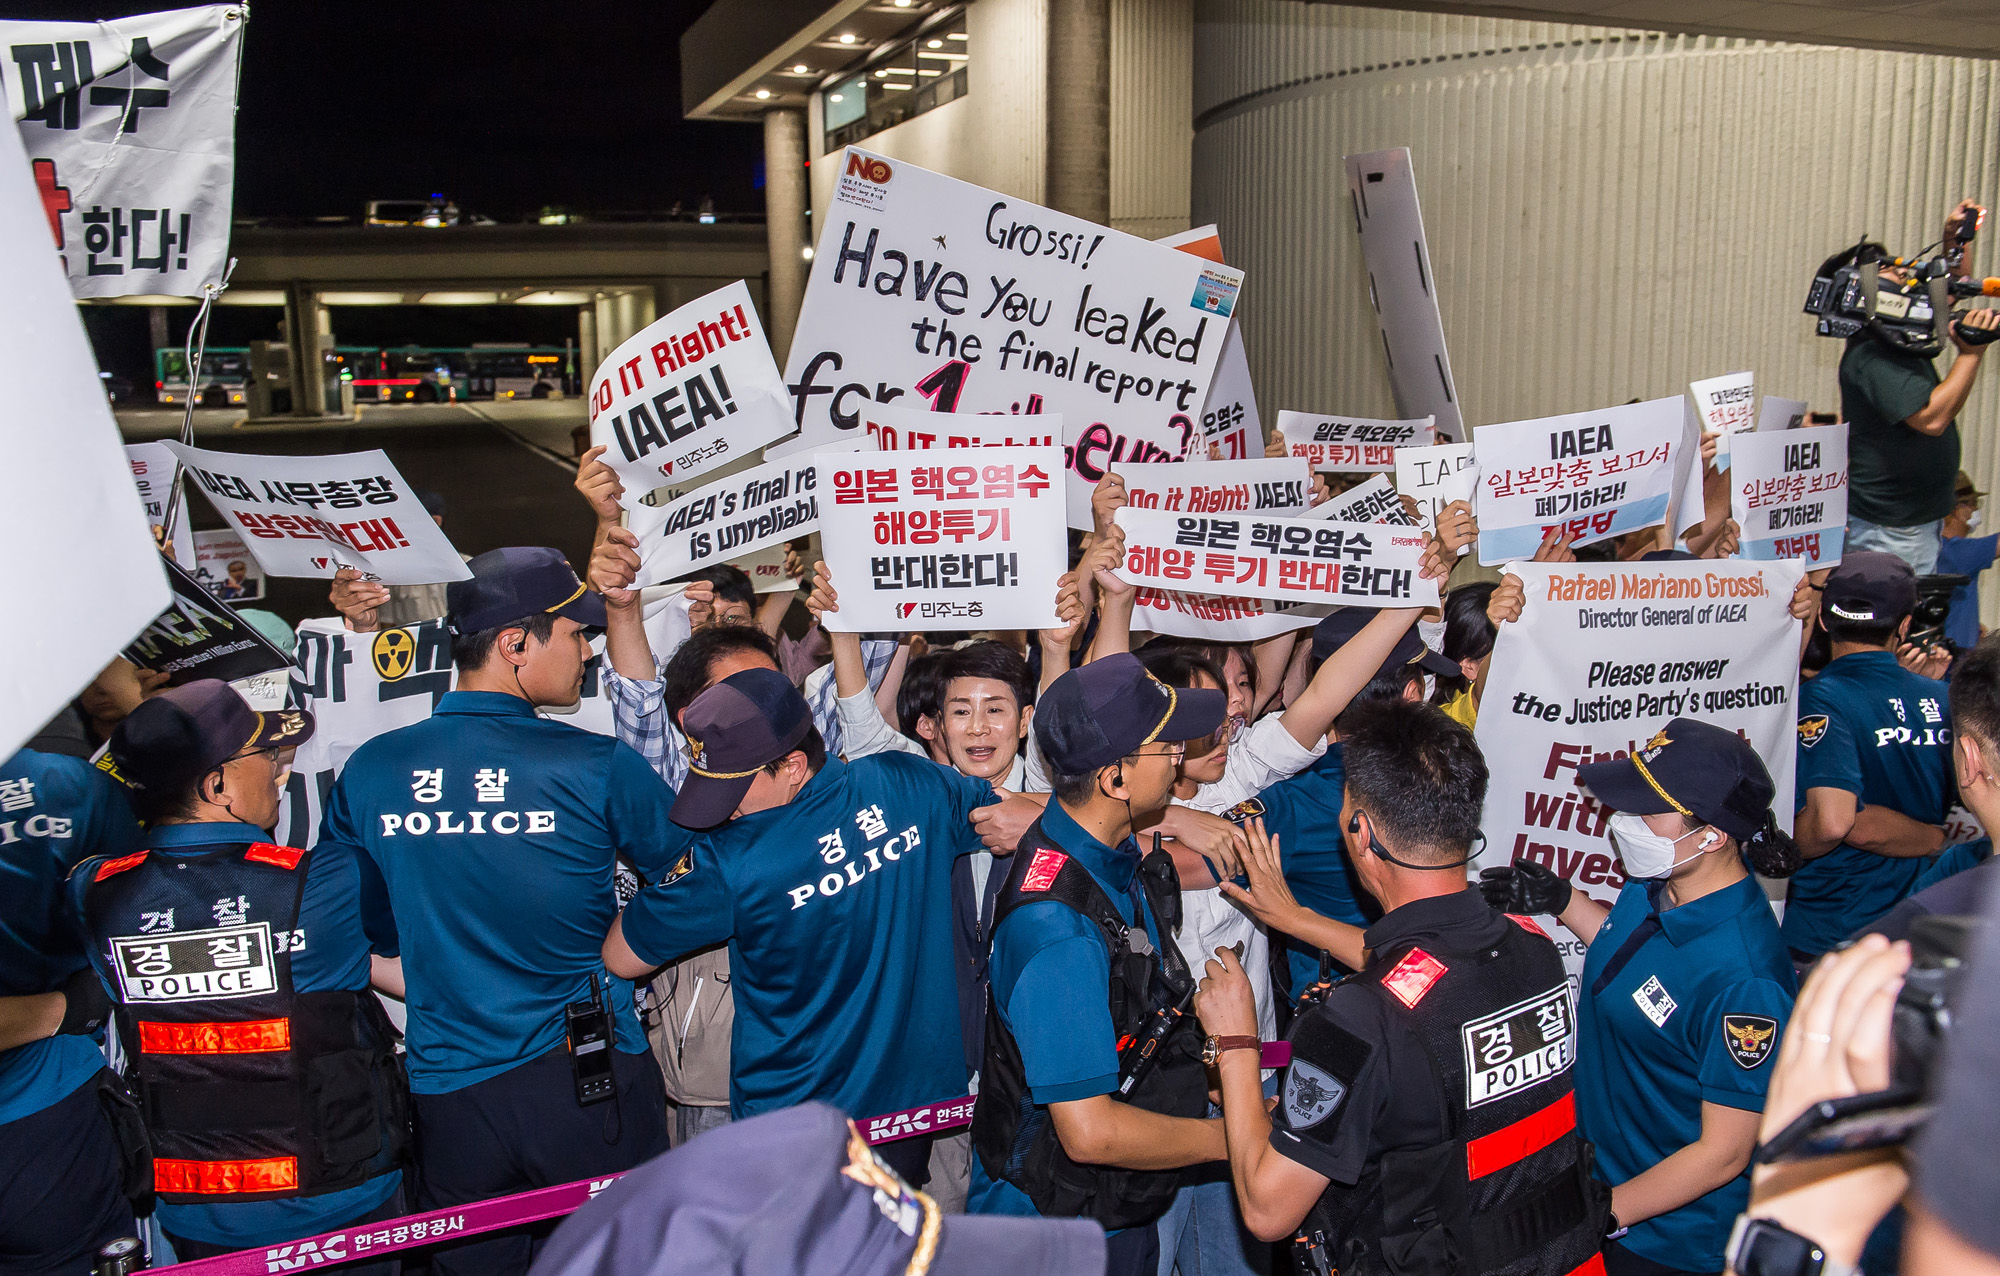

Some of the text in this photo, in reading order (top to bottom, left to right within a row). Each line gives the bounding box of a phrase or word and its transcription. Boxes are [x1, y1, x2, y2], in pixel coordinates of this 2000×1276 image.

[846, 152, 893, 184] NO
[82, 205, 192, 276] 한다!
[985, 201, 1105, 270] Grossi!
[833, 221, 969, 316] Have
[618, 354, 645, 398] IT
[650, 303, 752, 379] Right!
[911, 317, 1198, 412] the final report
[786, 351, 906, 434] for
[611, 363, 739, 464] IAEA!
[1312, 422, 1416, 443] 일본 핵오염수
[675, 436, 730, 471] 민주노총
[1328, 444, 1360, 466] 투기
[1550, 424, 1614, 460] IAEA
[1783, 441, 1821, 473] IAEA
[191, 465, 263, 503] IAEA
[259, 475, 400, 510] 사무총장
[832, 463, 1051, 505] 일본 핵오염수
[1487, 442, 1671, 499] 일본맞춤 보고서
[663, 489, 738, 537] IAEA's
[742, 470, 791, 512] final
[795, 464, 817, 495] re
[1164, 487, 1183, 512] it
[1187, 484, 1250, 514] Right!
[1254, 480, 1304, 510] IAEA!
[1534, 481, 1627, 519] 폐기하라!
[1742, 473, 1808, 509] 일본맞춤
[690, 531, 712, 561] is
[717, 495, 819, 552] unreliabl
[872, 508, 1012, 547] 해양투기
[1768, 502, 1825, 531] 폐기하라!
[1175, 517, 1373, 562] 일본 핵오염수
[870, 552, 1020, 592] 반대한다!
[1127, 544, 1412, 598] 해양 투기 반대한다!
[1547, 570, 1770, 601] Rafael Mariano Grossi,
[919, 599, 985, 619] 민주노총
[1186, 594, 1264, 622] Right!
[1578, 603, 1748, 629] Director General of IAEA
[1588, 657, 1730, 689] Please answer
[1511, 682, 1788, 726] the Justice Party's question.
[1888, 697, 1942, 723] 경 찰
[411, 768, 509, 803] 경 찰
[380, 810, 556, 837] POLICE
[818, 804, 889, 865] 경 찰
[786, 825, 922, 911] POLICE
[130, 944, 173, 975] 경
[207, 936, 252, 968] 찰
[140, 970, 254, 996] POLICE
[1644, 978, 1674, 1016] 경 찰
[1637, 992, 1662, 1023] POLICE
[1480, 1000, 1566, 1066] 경 찰
[1486, 1041, 1568, 1095] POLICE
[1737, 1050, 1760, 1059] POLICE
[869, 1102, 975, 1141] KAC 한국공
[1289, 1104, 1313, 1120] POLICE
[265, 1214, 466, 1273] KAC 한국공항공사
